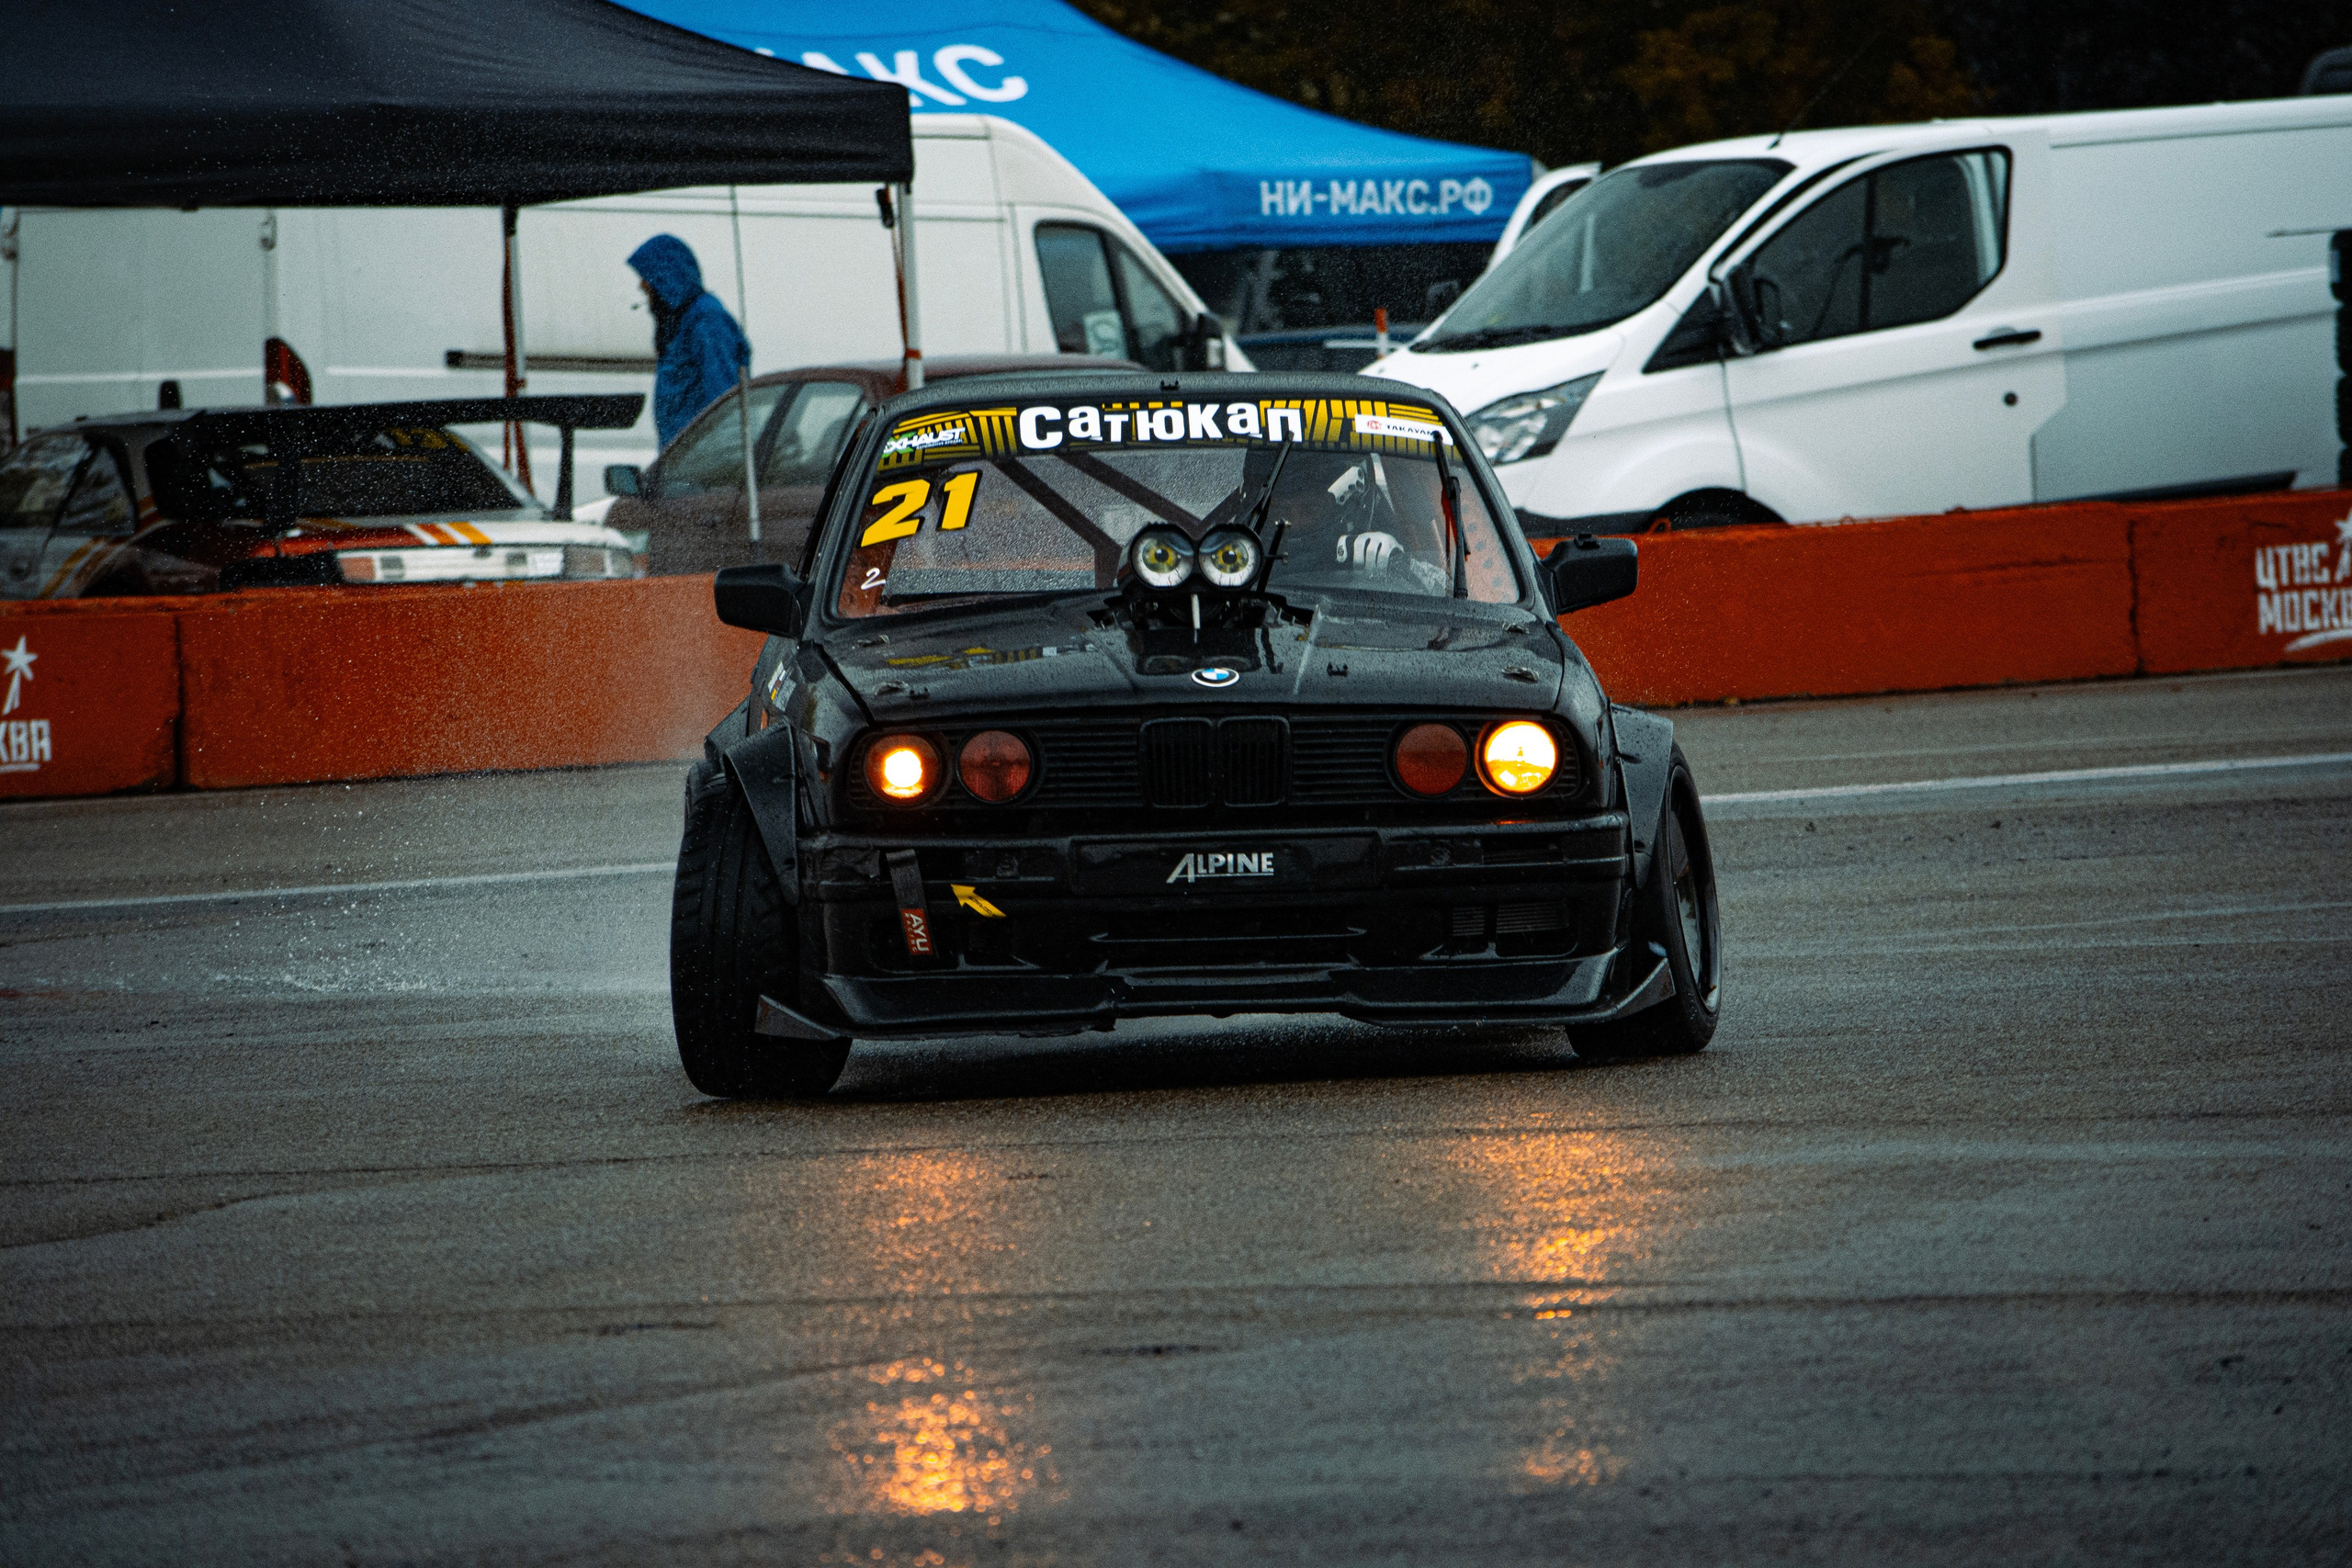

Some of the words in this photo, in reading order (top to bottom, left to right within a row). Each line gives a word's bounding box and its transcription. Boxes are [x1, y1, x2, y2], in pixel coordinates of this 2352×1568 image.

[754, 43, 1028, 107] КС
[1260, 177, 1493, 216] НИ-МАКС.РФ
[861, 472, 978, 547] 21
[2256, 541, 2330, 592] ЦТВС
[1166, 852, 1273, 884] ALPINE
[910, 913, 929, 952] AYU
